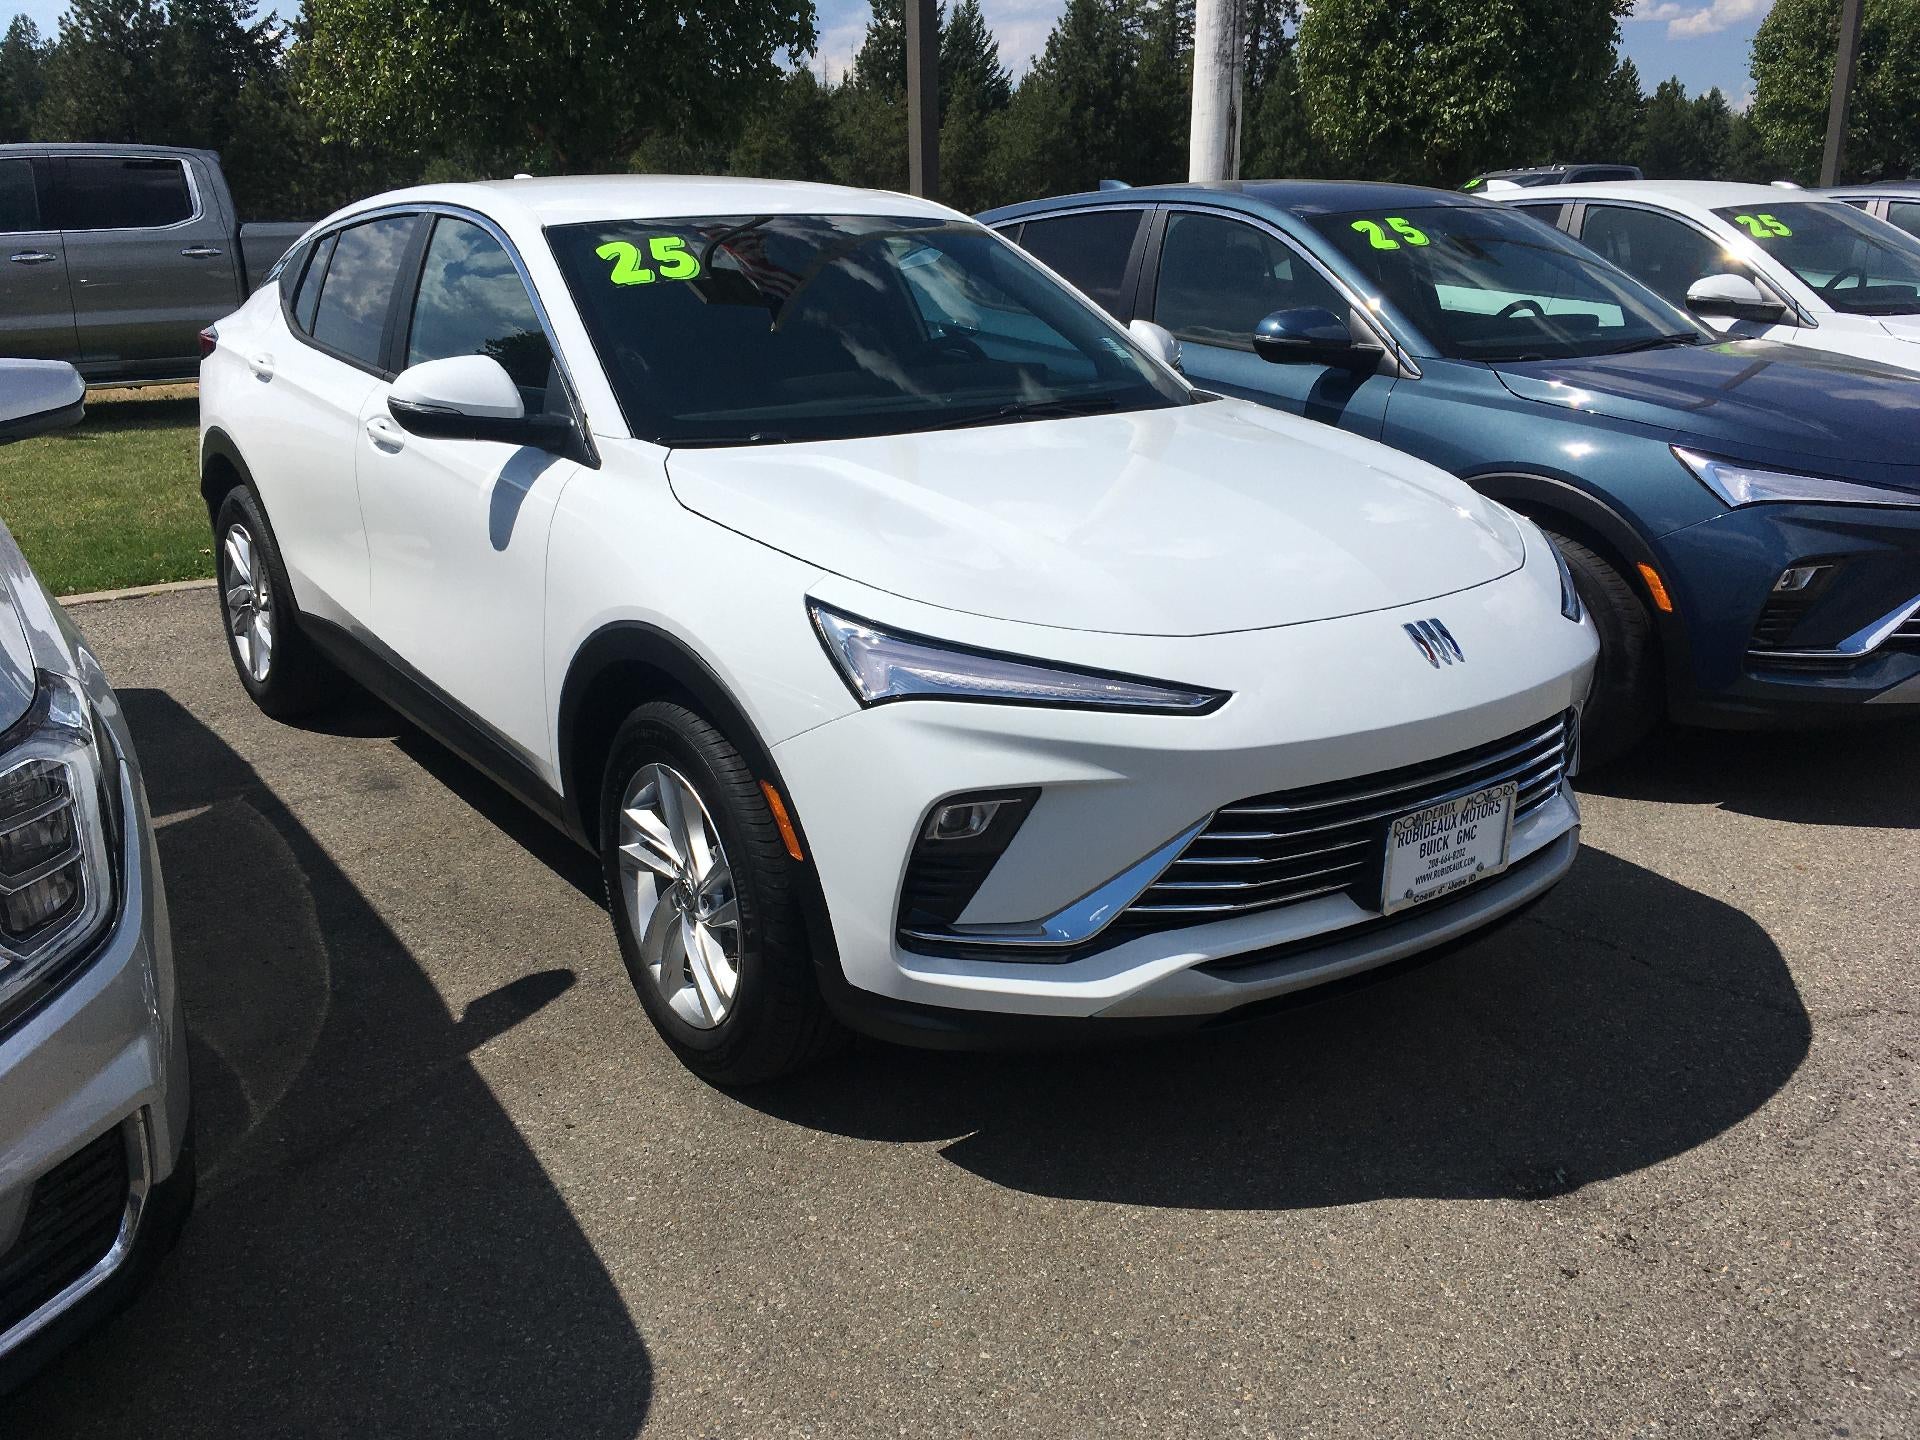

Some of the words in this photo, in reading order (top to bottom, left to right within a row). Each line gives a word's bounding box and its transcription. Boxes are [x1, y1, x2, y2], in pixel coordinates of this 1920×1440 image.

[1350, 217, 1430, 250] 25
[1734, 214, 1792, 237] 25
[595, 236, 700, 286] 25
[1397, 813, 1458, 848] ROBIDEAUX
[1460, 799, 1502, 826] MOTORS
[1420, 835, 1450, 859] BUICK
[1456, 824, 1478, 845] GMC
[1415, 856, 1476, 885] WWW.ROBIDEAUX.COM
[1413, 888, 1437, 903] Coeur
